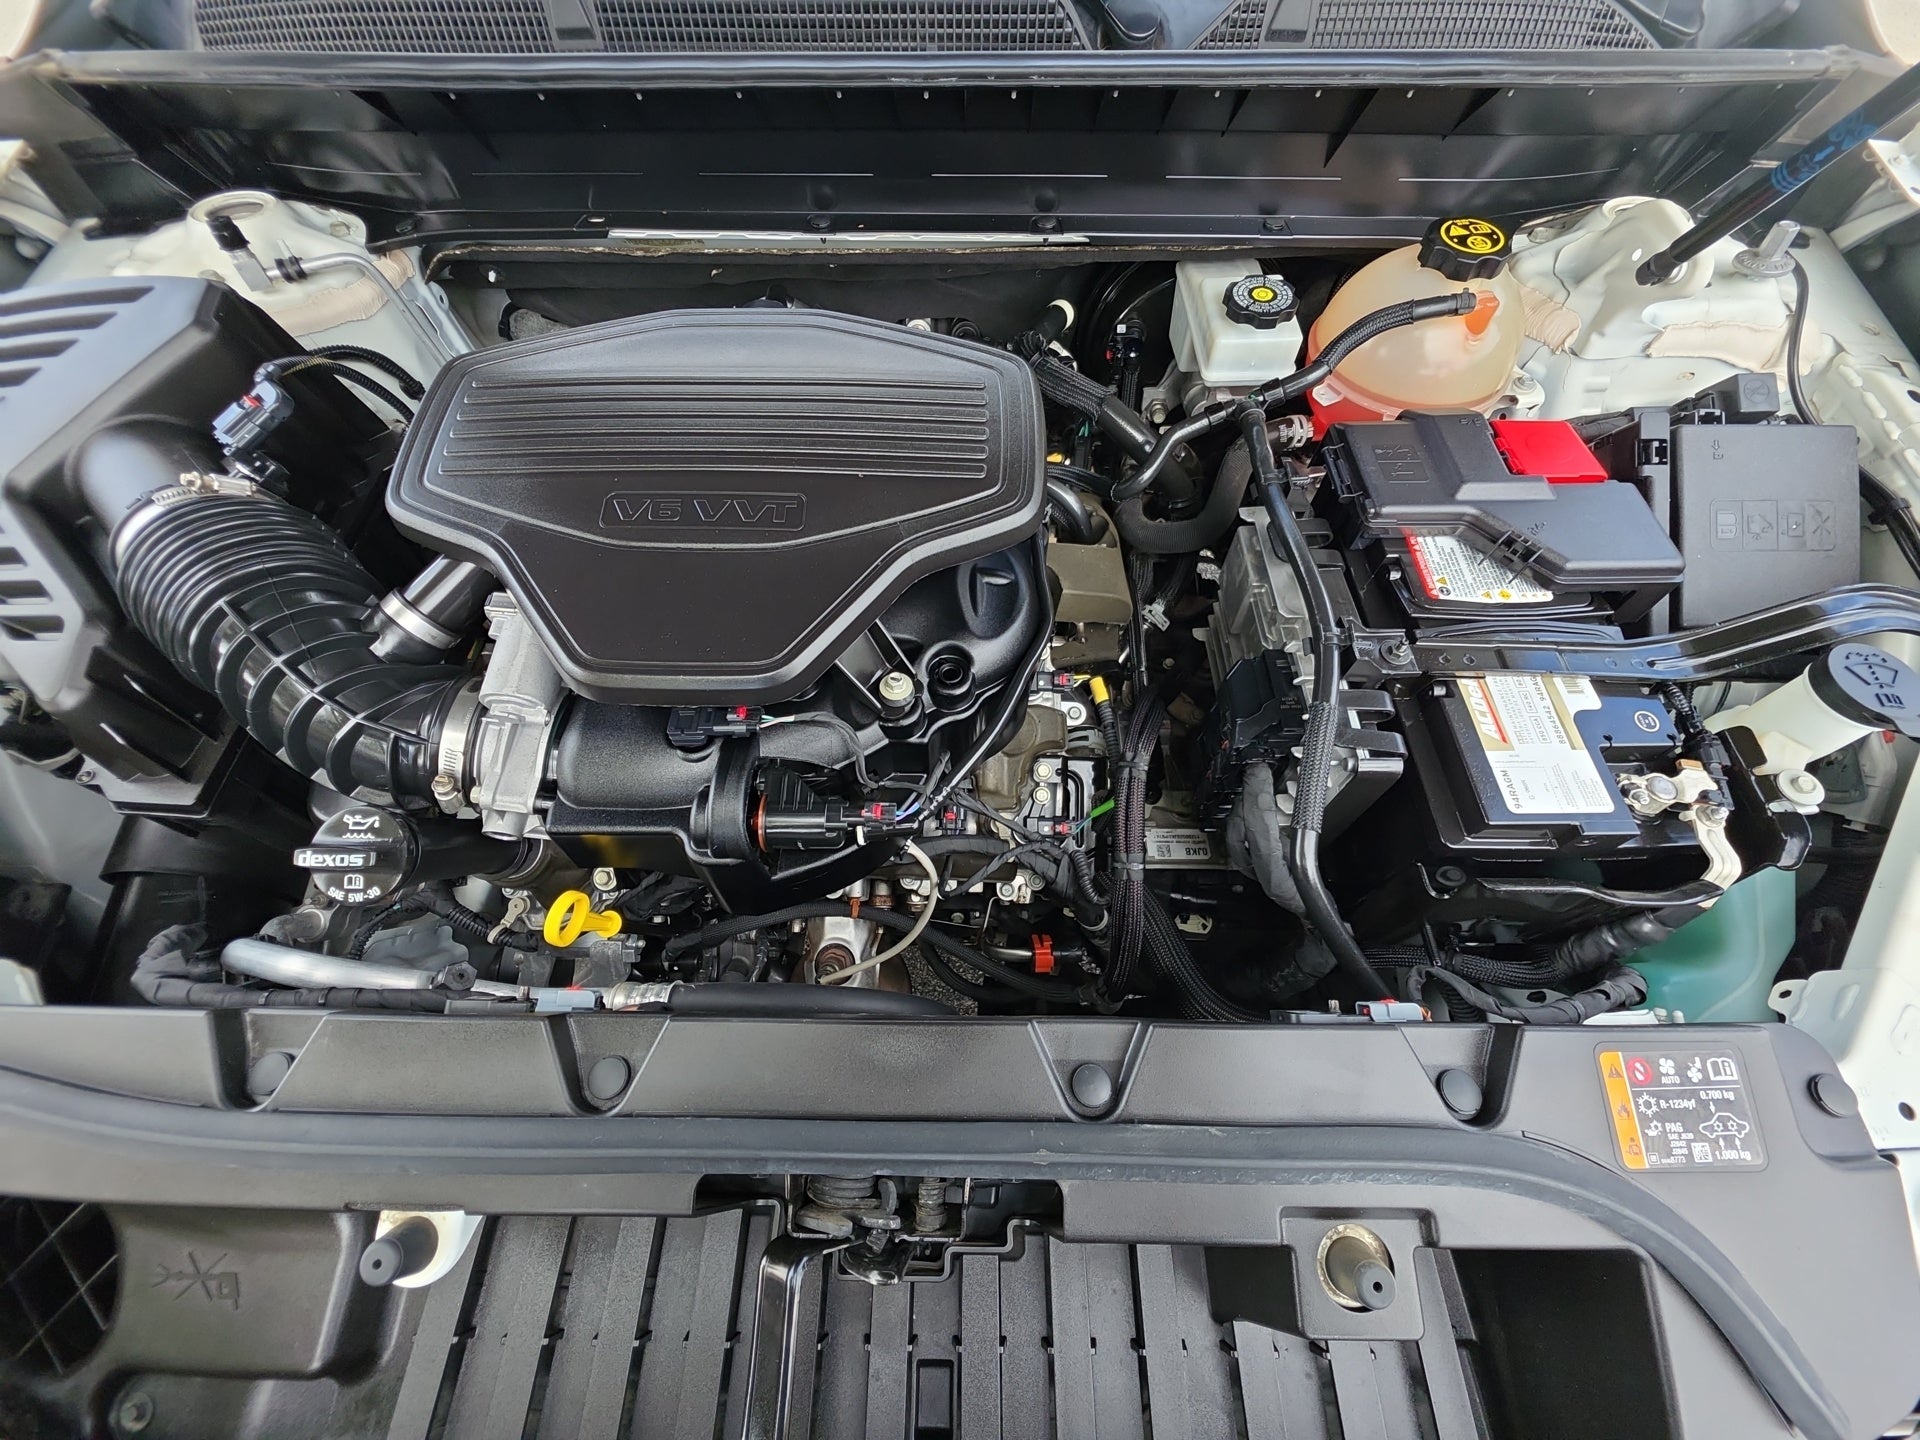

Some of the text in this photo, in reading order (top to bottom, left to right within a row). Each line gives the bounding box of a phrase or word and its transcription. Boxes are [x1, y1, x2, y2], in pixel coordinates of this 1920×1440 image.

[613, 499, 797, 523] V6 VVT
[1529, 676, 1547, 701] 94RAG
[1461, 677, 1502, 741] ACDel
[1521, 692, 1534, 711] 140 RC
[1533, 718, 1549, 741] 850 CCA
[1542, 705, 1567, 744] 88864542
[1499, 770, 1524, 809] 94RAGM
[298, 851, 366, 867] dexos
[328, 887, 381, 902] SAE 5W-30
[1661, 1076, 1680, 1084] AUTO
[1660, 1098, 1696, 1110] R-1234yf
[1700, 1091, 1735, 1101] 0.700 kg
[1665, 1122, 1684, 1133] PAG
[1715, 1151, 1751, 1161] 1.000 kg
